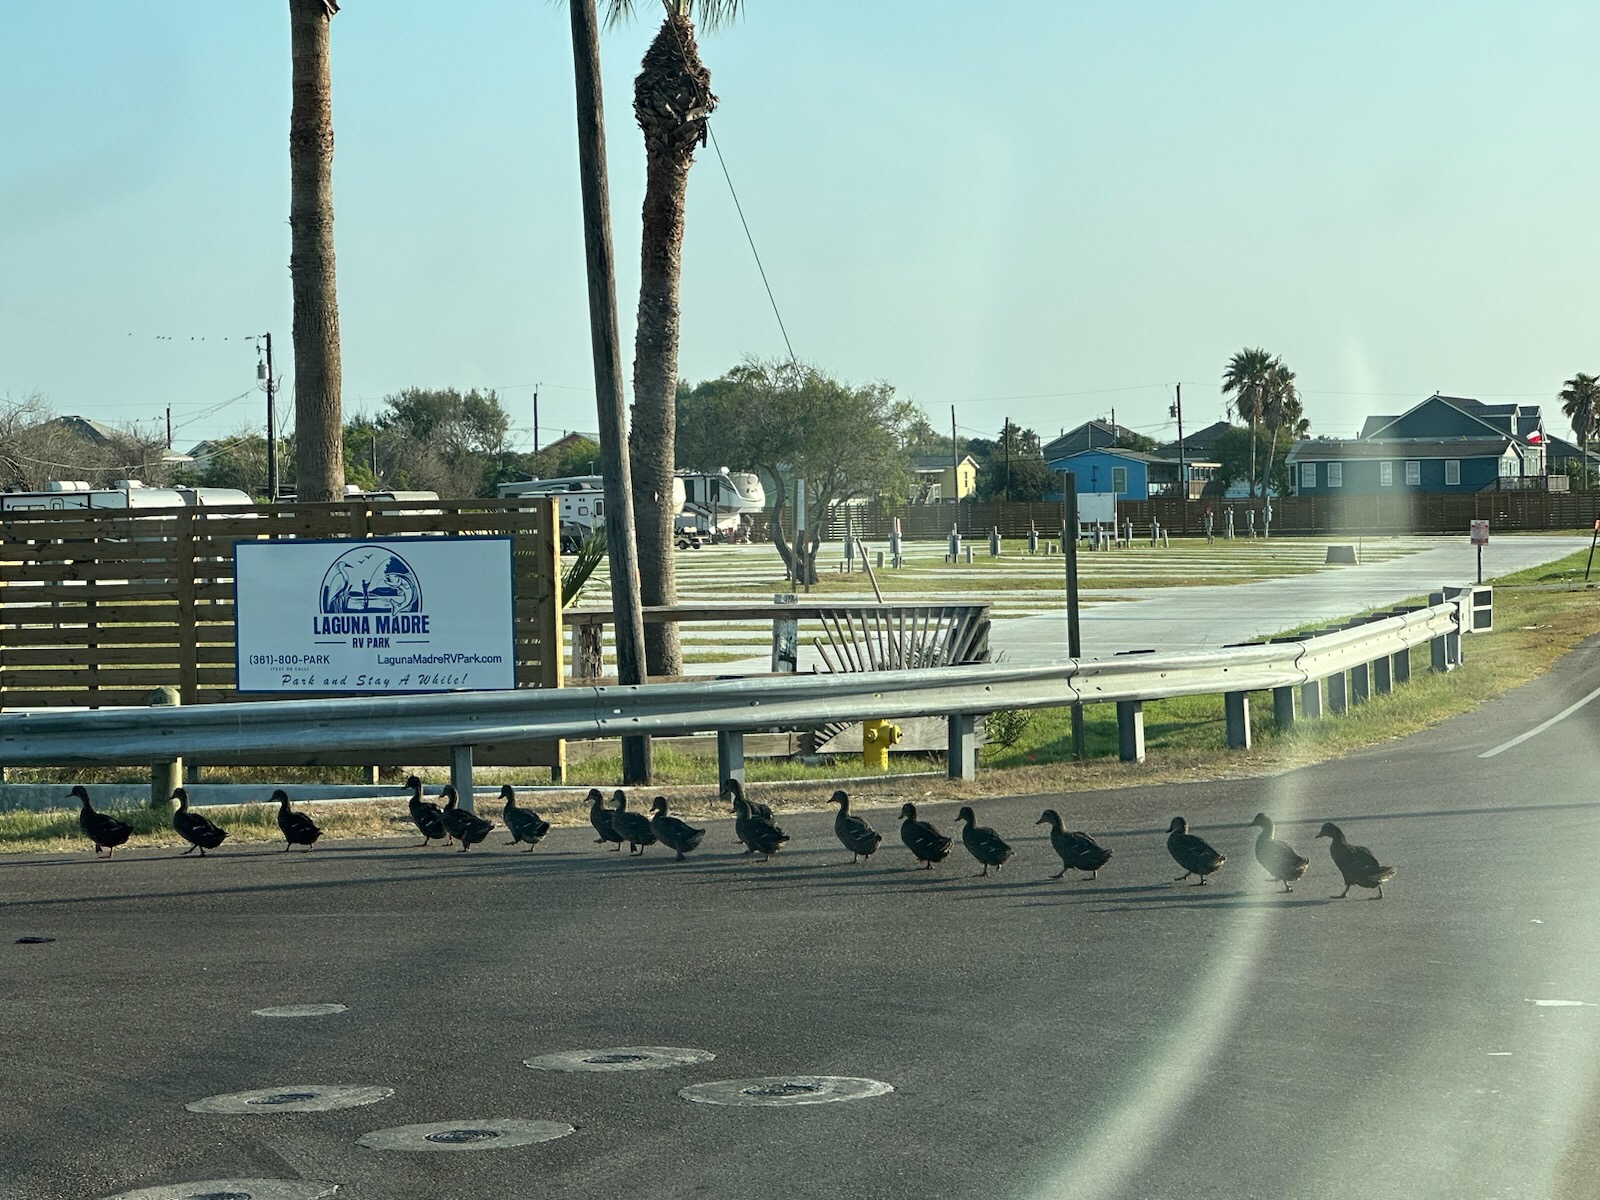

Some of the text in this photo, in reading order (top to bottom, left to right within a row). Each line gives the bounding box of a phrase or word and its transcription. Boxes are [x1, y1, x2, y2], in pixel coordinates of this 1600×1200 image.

[313, 615, 430, 635] LAGUNA MADRE
[352, 637, 390, 648] RV PARK
[249, 654, 330, 665] (361)-800-PARK
[378, 653, 502, 666] LagunaMadreRVPark.com
[281, 673, 468, 687] Park and Stay A While!
